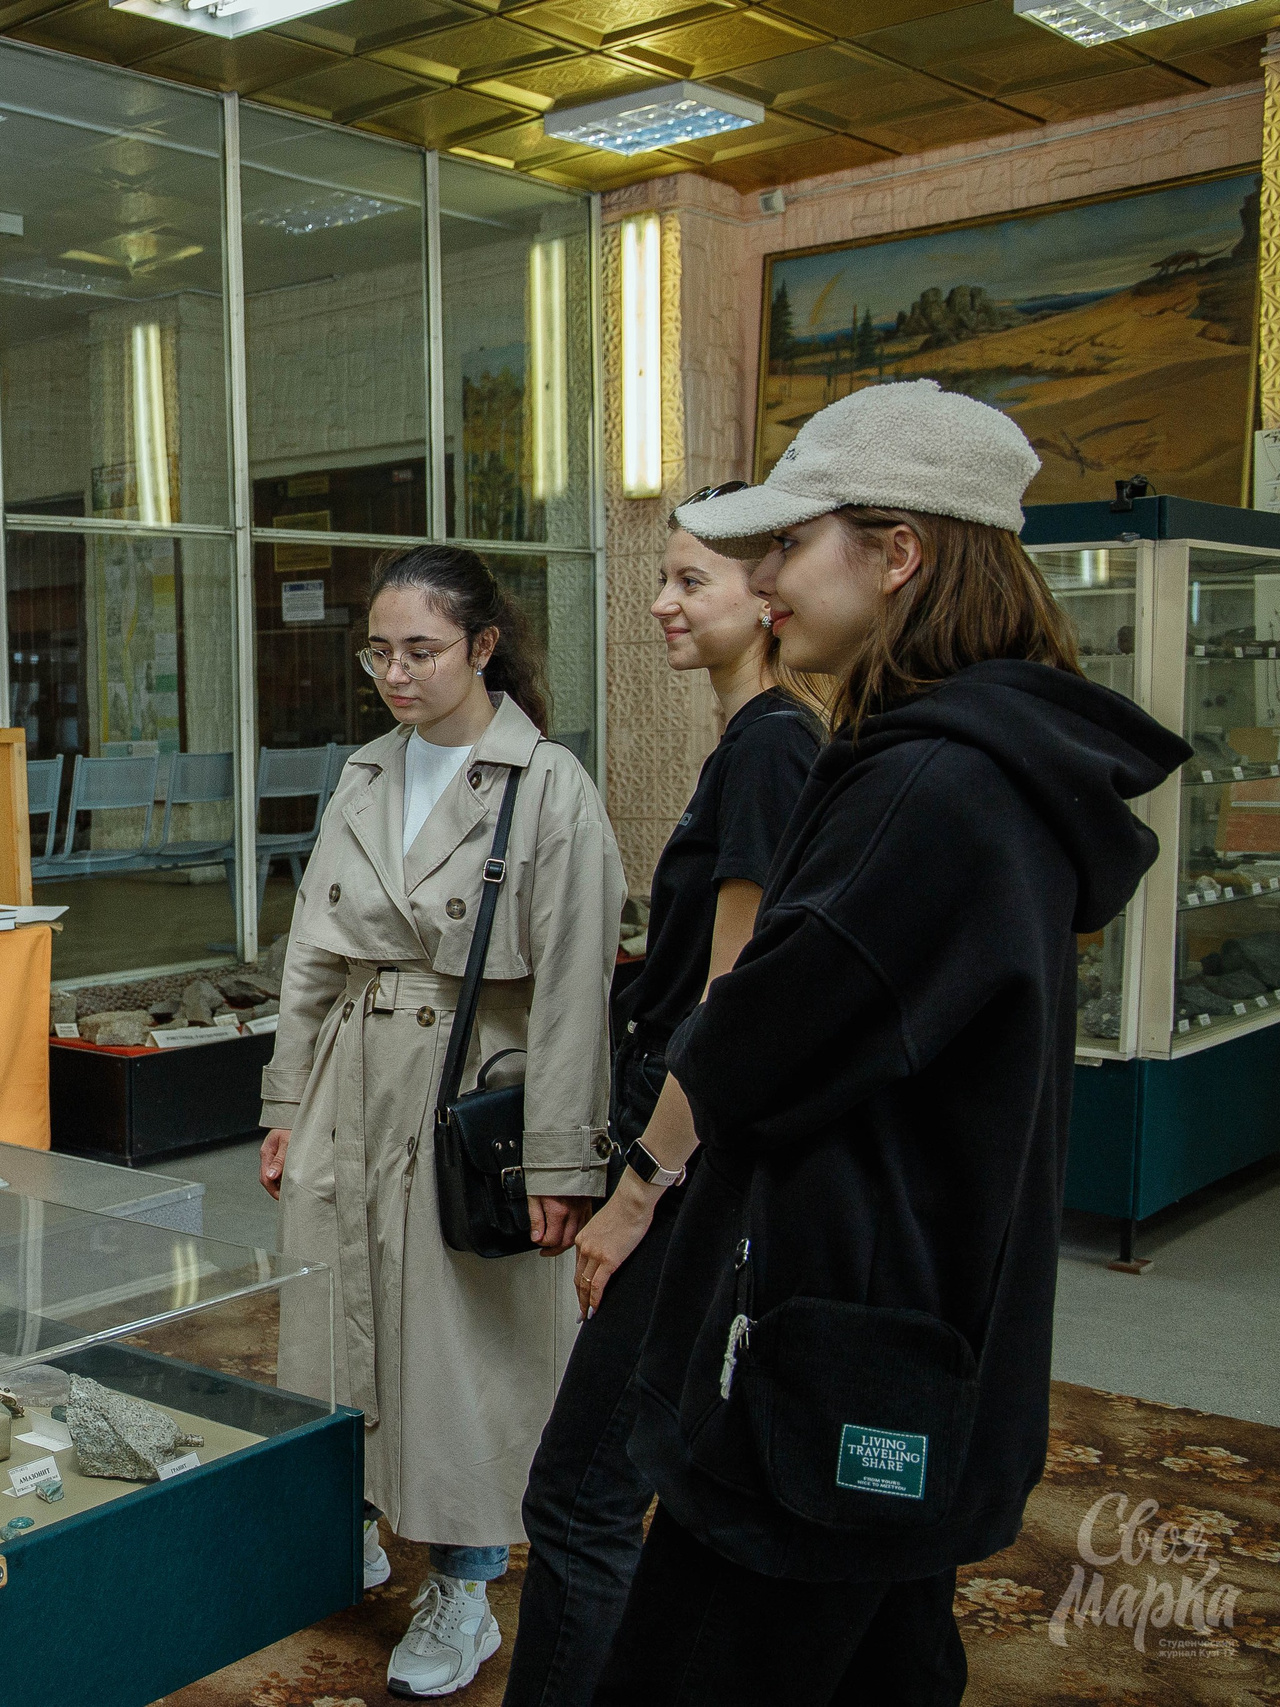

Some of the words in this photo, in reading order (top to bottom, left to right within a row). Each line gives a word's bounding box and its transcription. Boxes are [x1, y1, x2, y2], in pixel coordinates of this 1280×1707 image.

[861, 1435, 906, 1451] LIVING
[847, 1444, 920, 1463] TRAVELING
[861, 1457, 904, 1472] SHARE
[19, 1467, 51, 1484] АМАЗОНИТ
